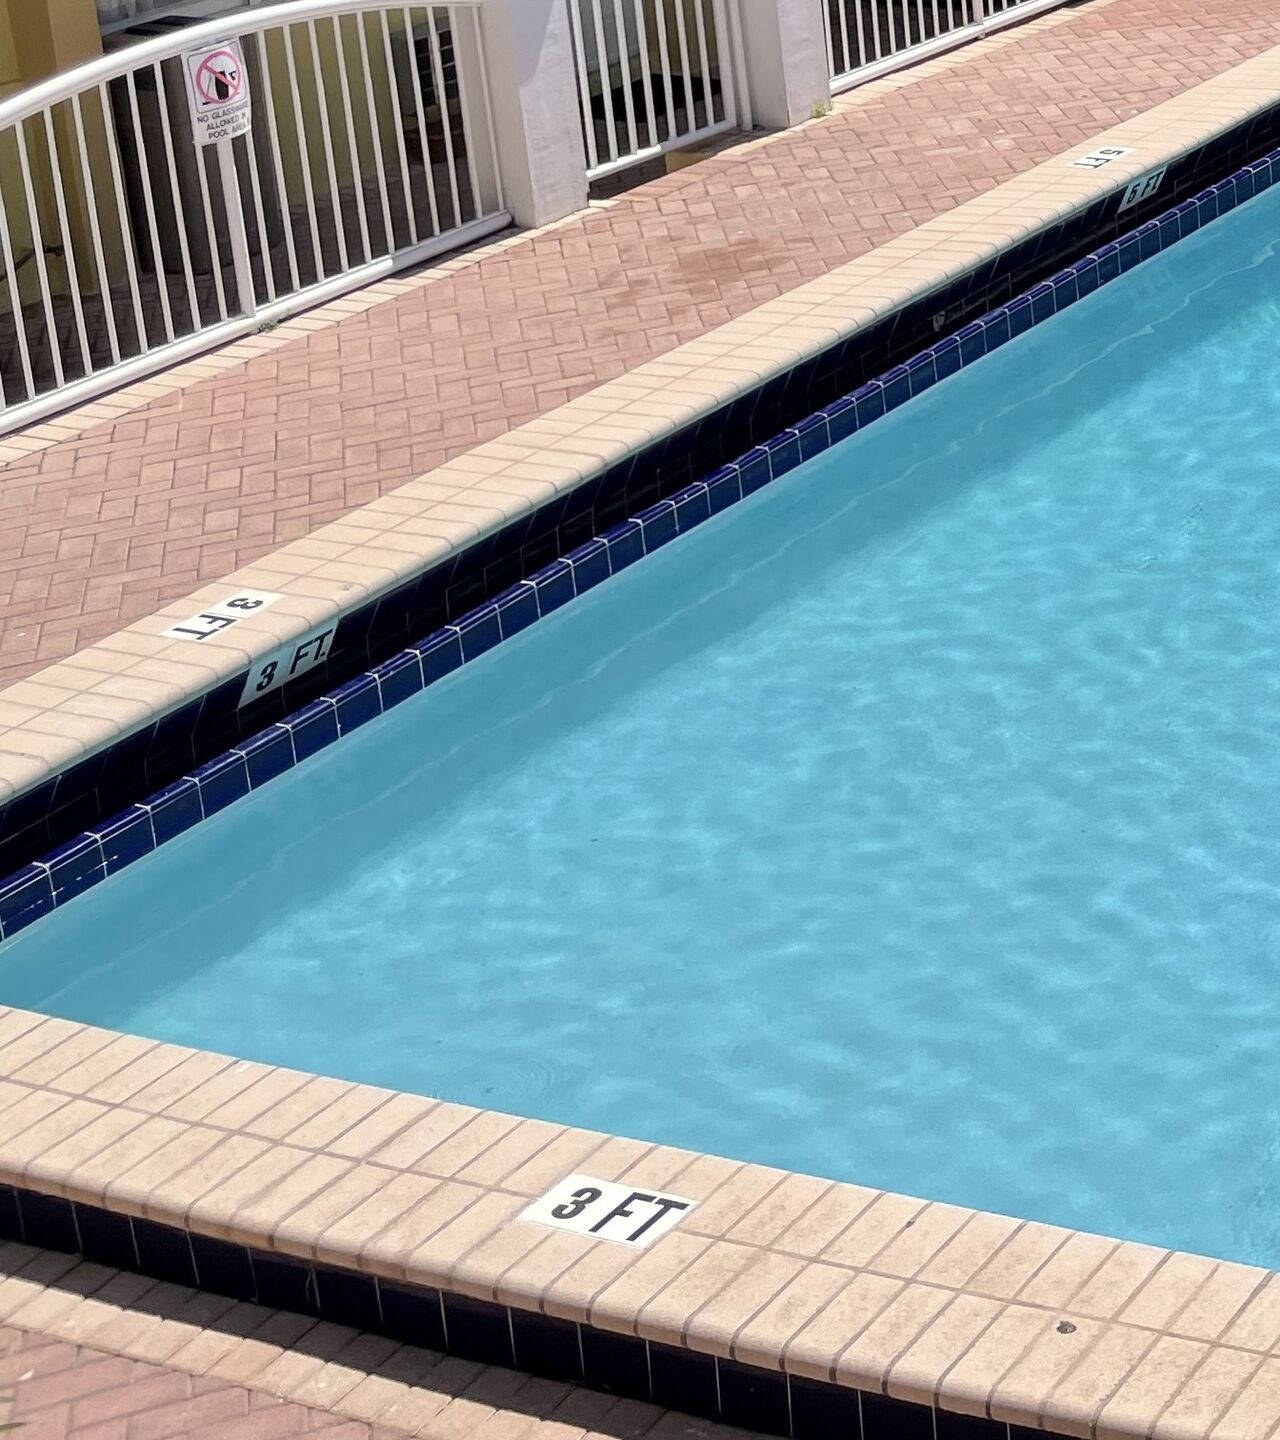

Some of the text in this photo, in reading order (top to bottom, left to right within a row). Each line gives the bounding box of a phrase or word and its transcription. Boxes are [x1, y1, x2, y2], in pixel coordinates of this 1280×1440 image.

[196, 114, 209, 124] NO
[208, 128, 230, 139] POOL
[1073, 156, 1113, 169] FT
[172, 597, 264, 641] 3 FT
[255, 660, 279, 693] 3
[551, 1187, 690, 1241] 3 FT
